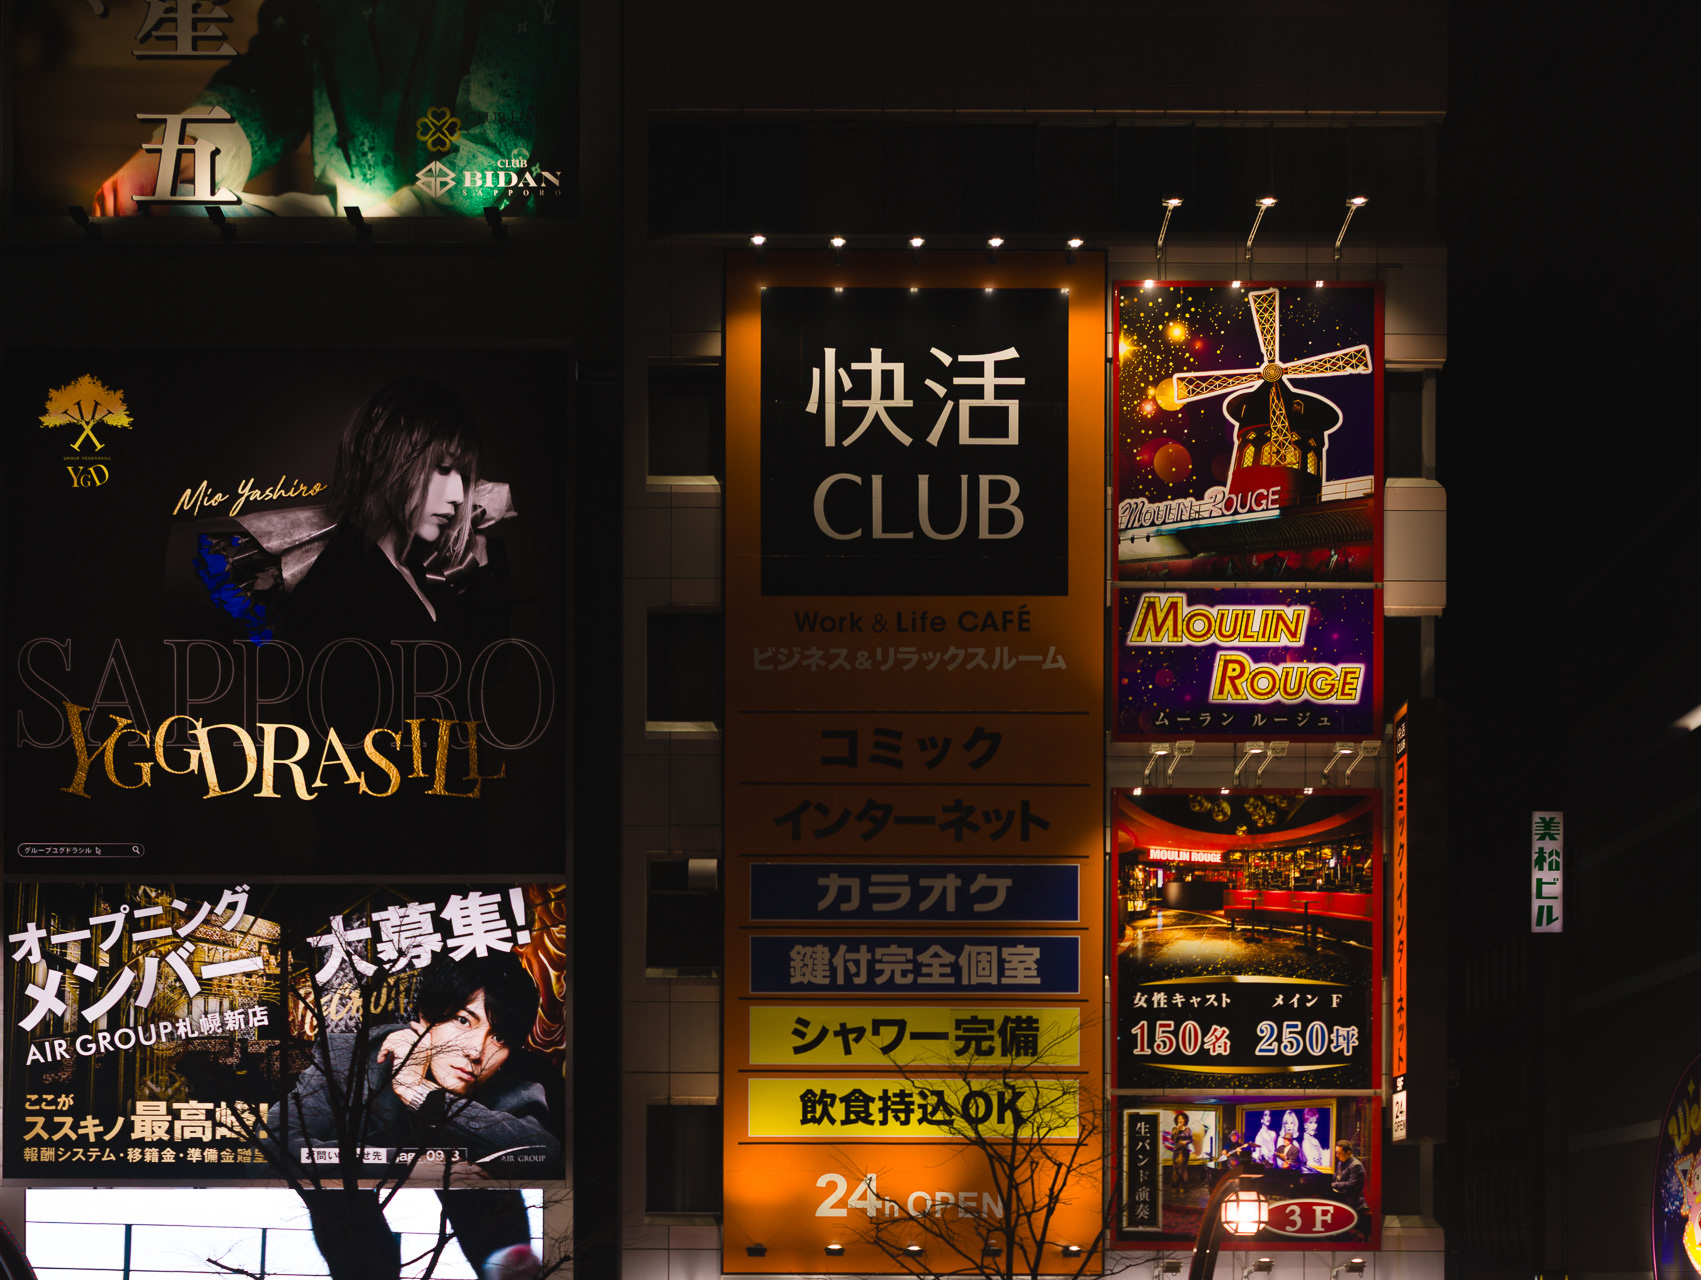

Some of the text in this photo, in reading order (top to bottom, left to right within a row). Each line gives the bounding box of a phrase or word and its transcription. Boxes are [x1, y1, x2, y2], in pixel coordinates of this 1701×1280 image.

[463, 171, 562, 187] BIDAN
[497, 159, 528, 168] CLUB
[805, 346, 1026, 447] 快活
[173, 474, 328, 516] Mio Yashiro
[813, 472, 1025, 541] CLUB
[1204, 486, 1281, 517] ROUGE
[794, 605, 1031, 633] Work & Life CAFÉ
[1130, 596, 1305, 643] MOULIN
[17, 637, 555, 750] SAPPORO
[1212, 654, 1361, 701] ROUGE
[1155, 711, 1332, 727] ムーラン ルージュ
[61, 701, 507, 801] YGGDRASILL
[820, 726, 1002, 770] コミック
[774, 799, 1050, 842] インターネット
[24, 846, 92, 854] グループユグドラシル
[1150, 849, 1222, 863] MOULIN ROUGE
[817, 872, 1013, 912] カラオケ
[1534, 817, 1560, 927] 美松ビル
[8, 883, 250, 966] オープニング
[789, 944, 1041, 986] 鍵付完全個室
[18, 941, 264, 1033] メンバー
[1132, 991, 1232, 1009] 女性キャスト
[1271, 993, 1319, 1009] メイン
[26, 1039, 70, 1066] AIR
[790, 1016, 1040, 1058] シャワー完備
[1131, 1020, 1231, 1056] 150名
[1255, 1020, 1359, 1056] 250坪
[25, 1094, 74, 1111] ここが
[799, 1088, 1027, 1127] 飲食持込OK
[1135, 1121, 1151, 1221] 生バンド演奏
[814, 1172, 1003, 1220] 24h OPEN
[1284, 1205, 1335, 1232] 3F
